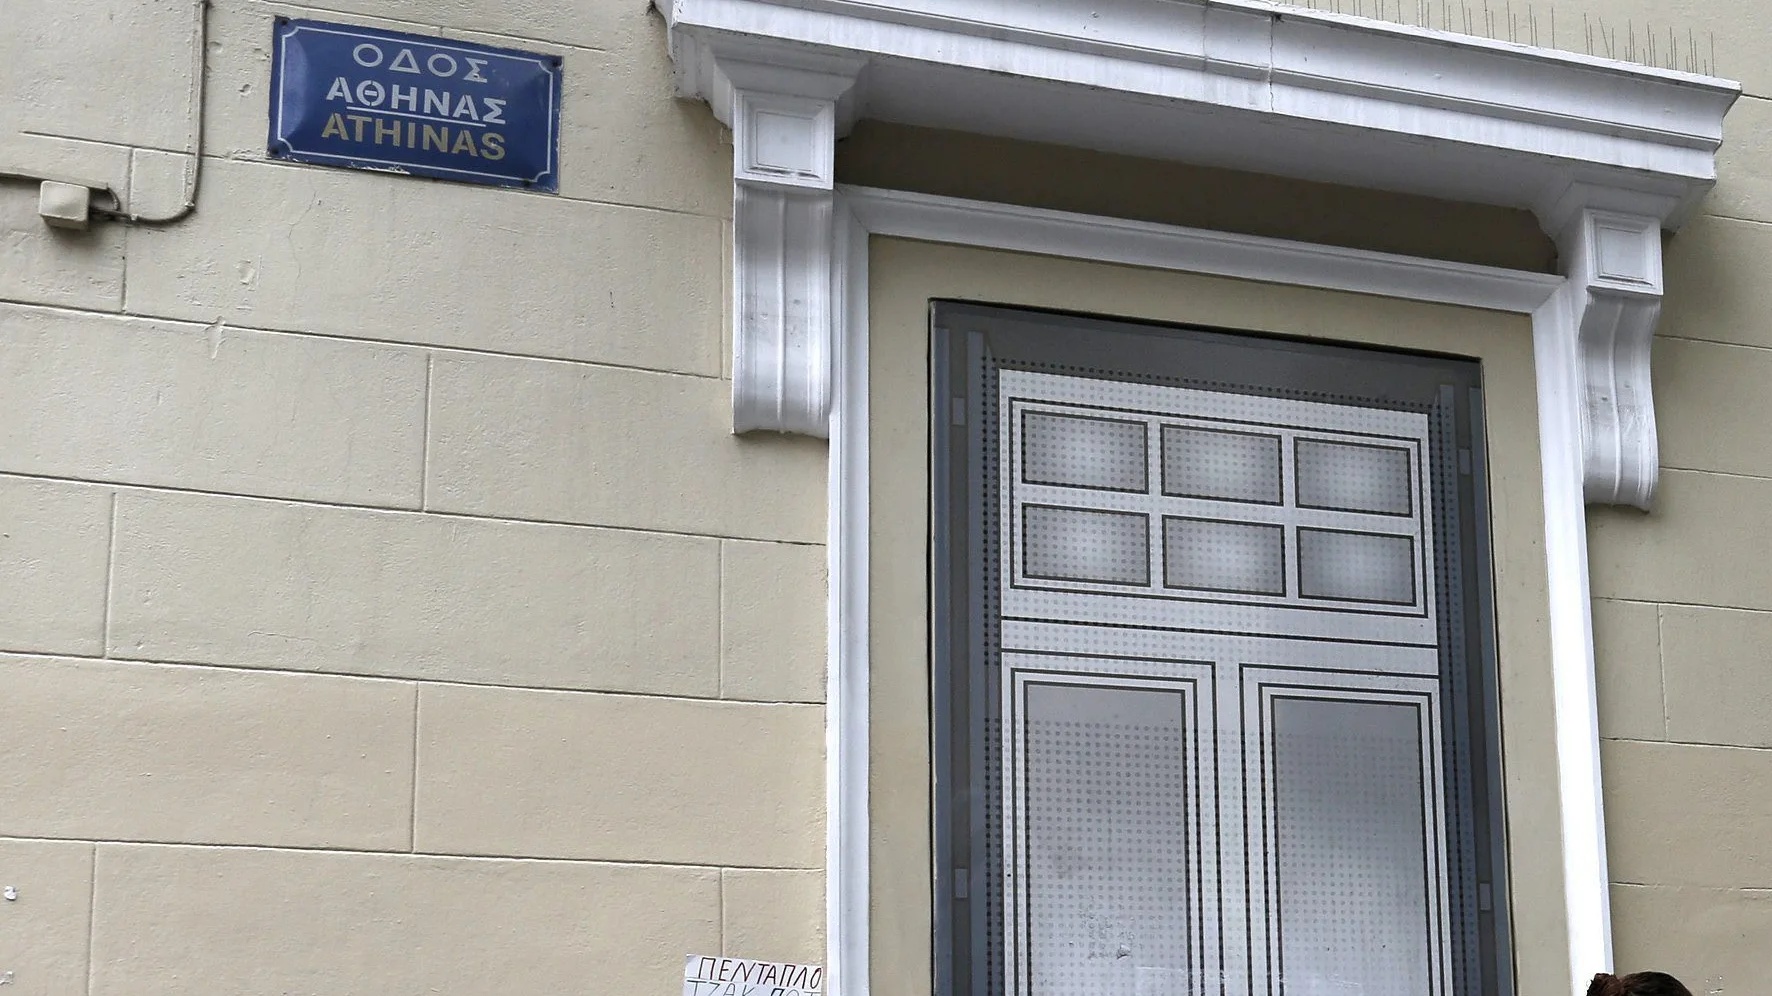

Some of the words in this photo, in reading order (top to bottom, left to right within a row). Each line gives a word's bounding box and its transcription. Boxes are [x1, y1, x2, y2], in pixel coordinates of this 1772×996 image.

[352, 43, 488, 84] ΟΔΟΣ
[326, 76, 507, 125] ΑΘΗΝΑΣ
[321, 112, 505, 161] ATHINAS
[698, 956, 822, 990] ΠΕΝΤΑΠΛΟ
